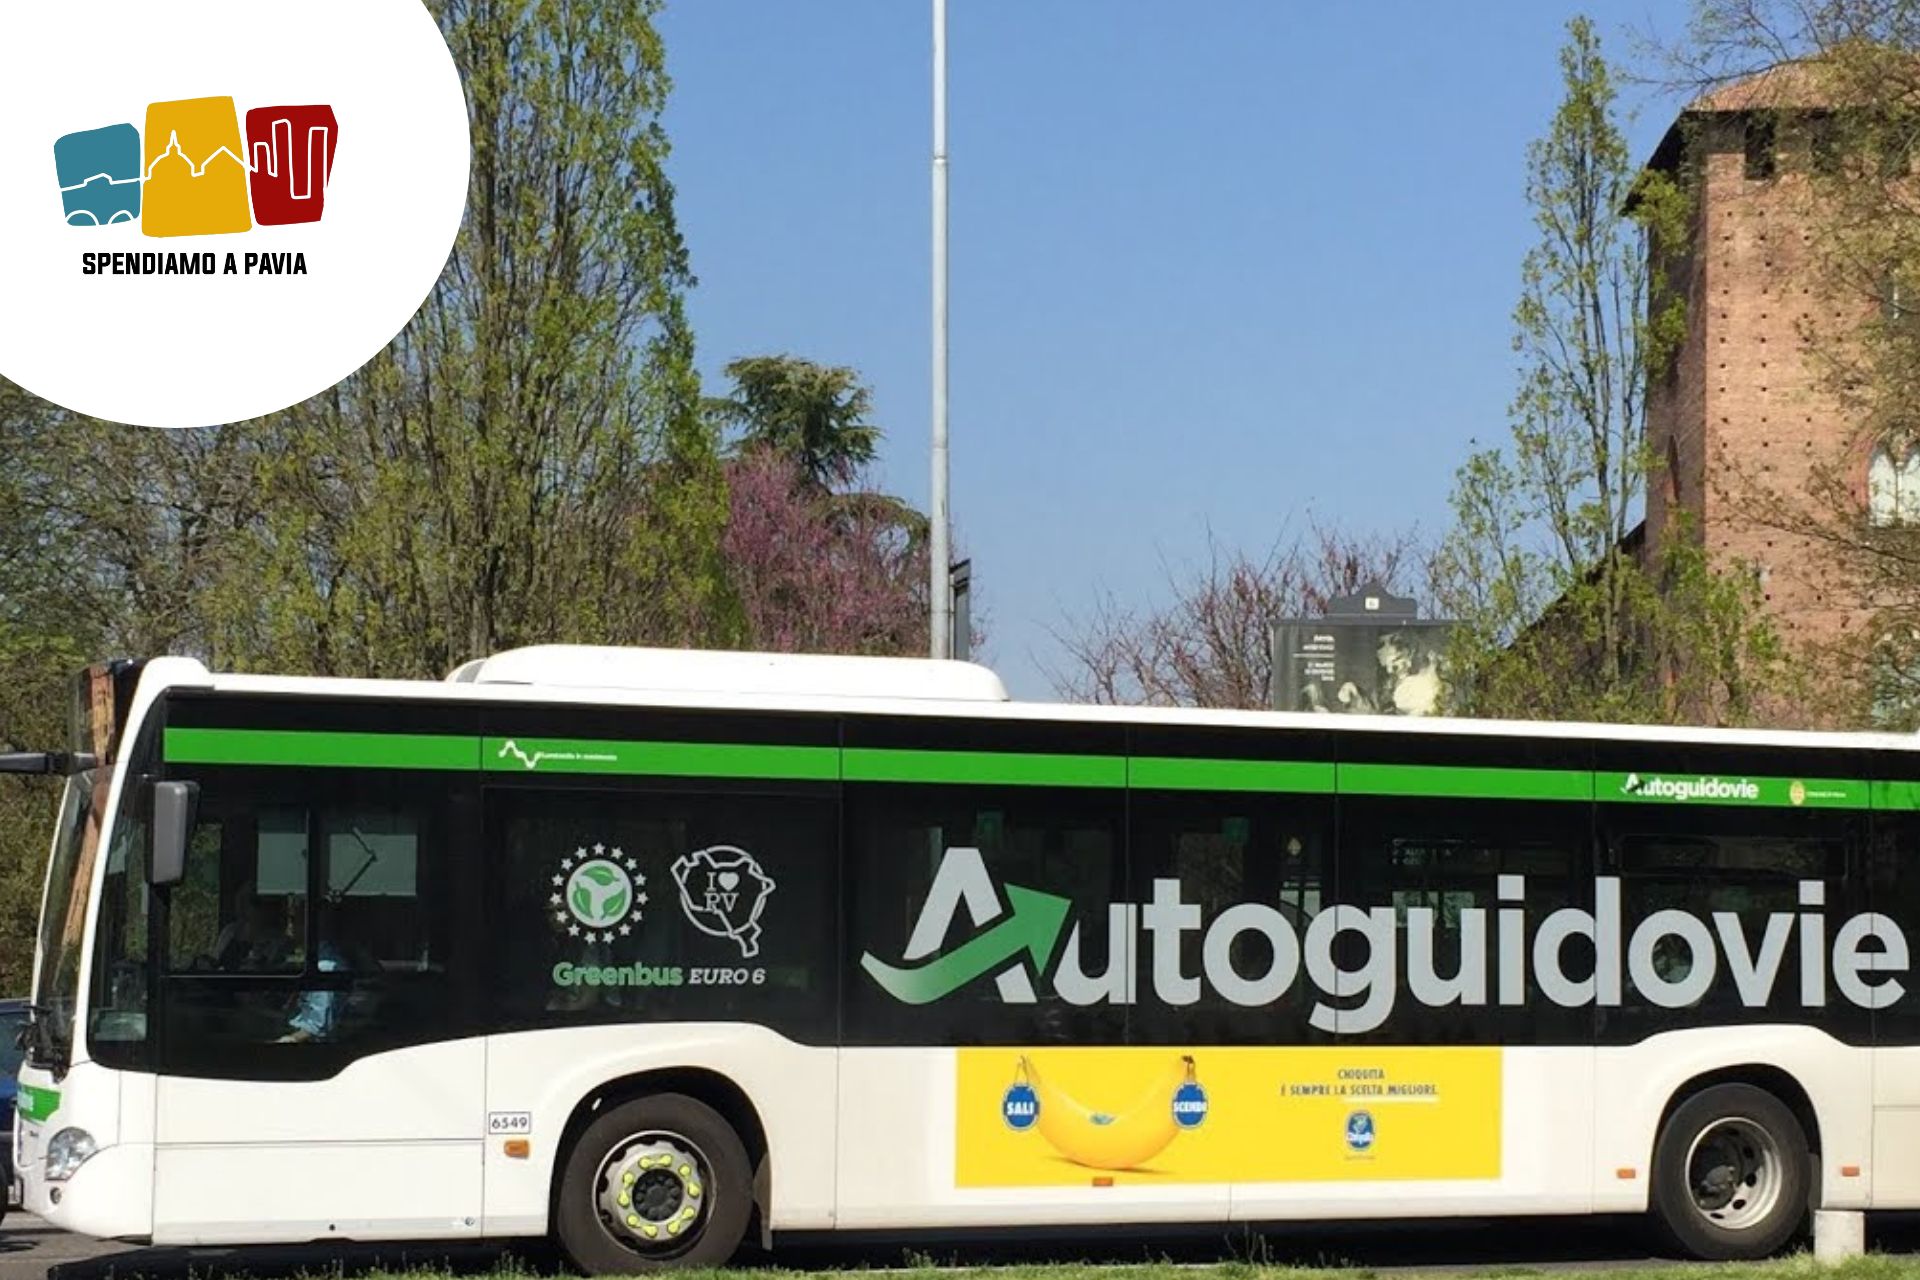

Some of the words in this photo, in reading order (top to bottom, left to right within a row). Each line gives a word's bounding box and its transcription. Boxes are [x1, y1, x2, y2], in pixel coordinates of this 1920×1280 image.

[1621, 772, 1759, 801] Autoguidovie
[706, 872, 717, 892] I
[860, 846, 1910, 1034] Autoguidovie
[552, 961, 684, 987] Greenbus
[688, 967, 749, 985] EURO
[752, 967, 766, 985] 6
[1007, 1101, 1034, 1116] SALI
[491, 1116, 528, 1129] 6549
